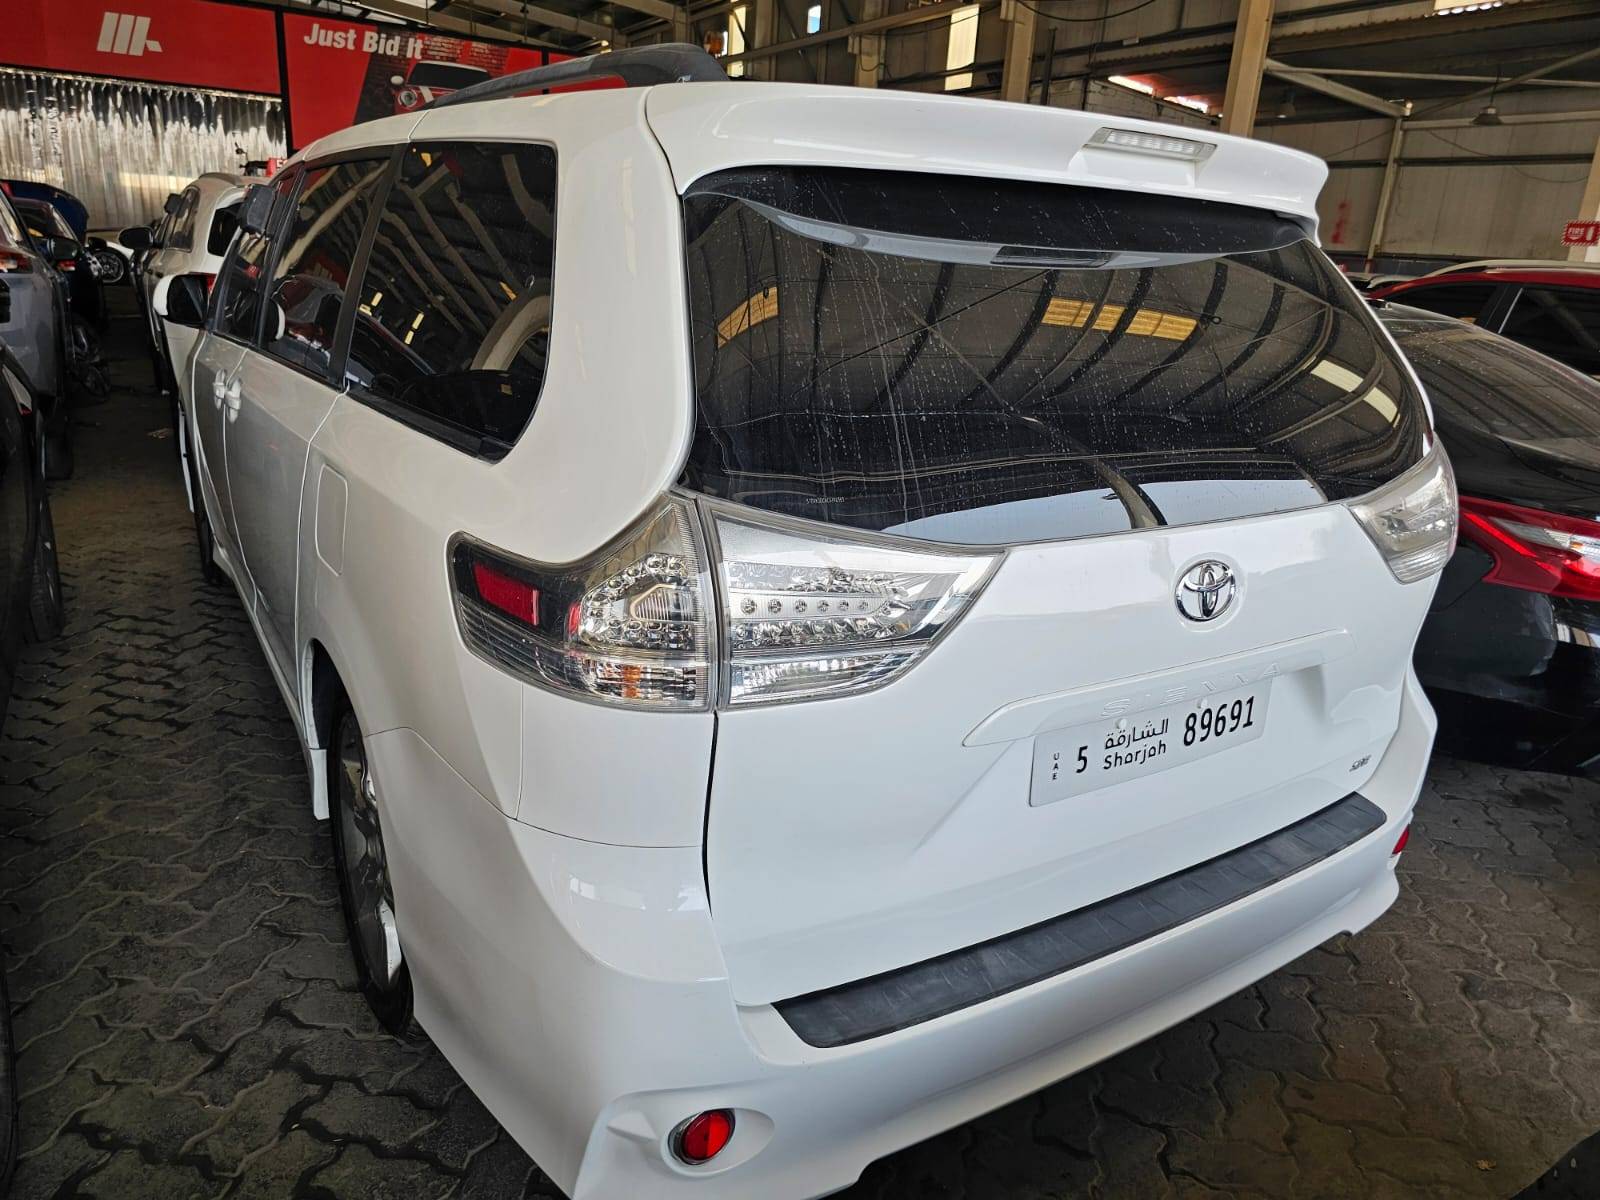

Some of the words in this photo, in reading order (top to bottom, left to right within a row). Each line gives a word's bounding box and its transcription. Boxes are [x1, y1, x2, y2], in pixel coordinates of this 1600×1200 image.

[303, 23, 356, 50] Just
[362, 30, 400, 57] Bid
[406, 37, 422, 60] It
[1104, 718, 1169, 750] الشارقة
[1183, 695, 1255, 747] 89691
[1052, 752, 1060, 780] UAE
[1076, 745, 1088, 773] 5
[1103, 740, 1167, 770] Sharjah
